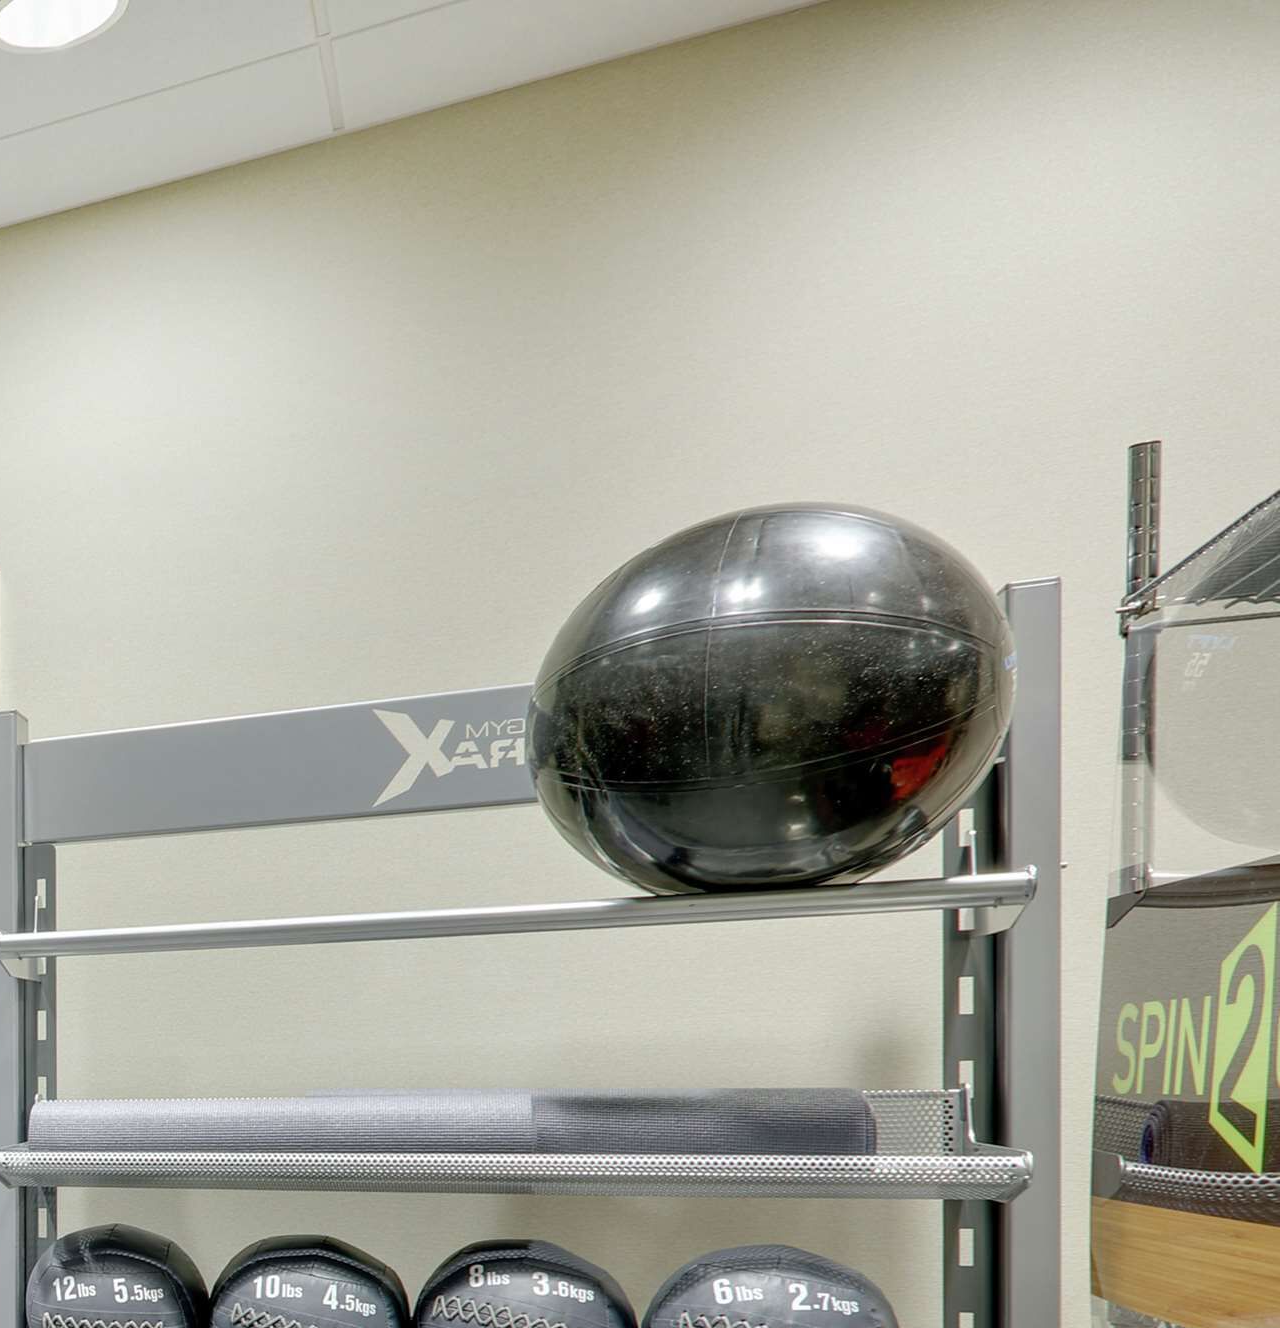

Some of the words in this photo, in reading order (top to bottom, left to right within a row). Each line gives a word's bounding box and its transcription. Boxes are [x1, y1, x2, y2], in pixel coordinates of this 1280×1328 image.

[1112, 901, 1280, 1176] SPIN2
[53, 1275, 97, 1301] 12lbs
[113, 1278, 164, 1303] 5.5kgs
[253, 1274, 303, 1299] 10lbs
[322, 1284, 377, 1317] 4.5kgs
[468, 1264, 511, 1288] 8lbs
[532, 1271, 595, 1303] 3.6kgs
[712, 1278, 764, 1305] 6lbs
[788, 1283, 860, 1316] 2.7kgs
